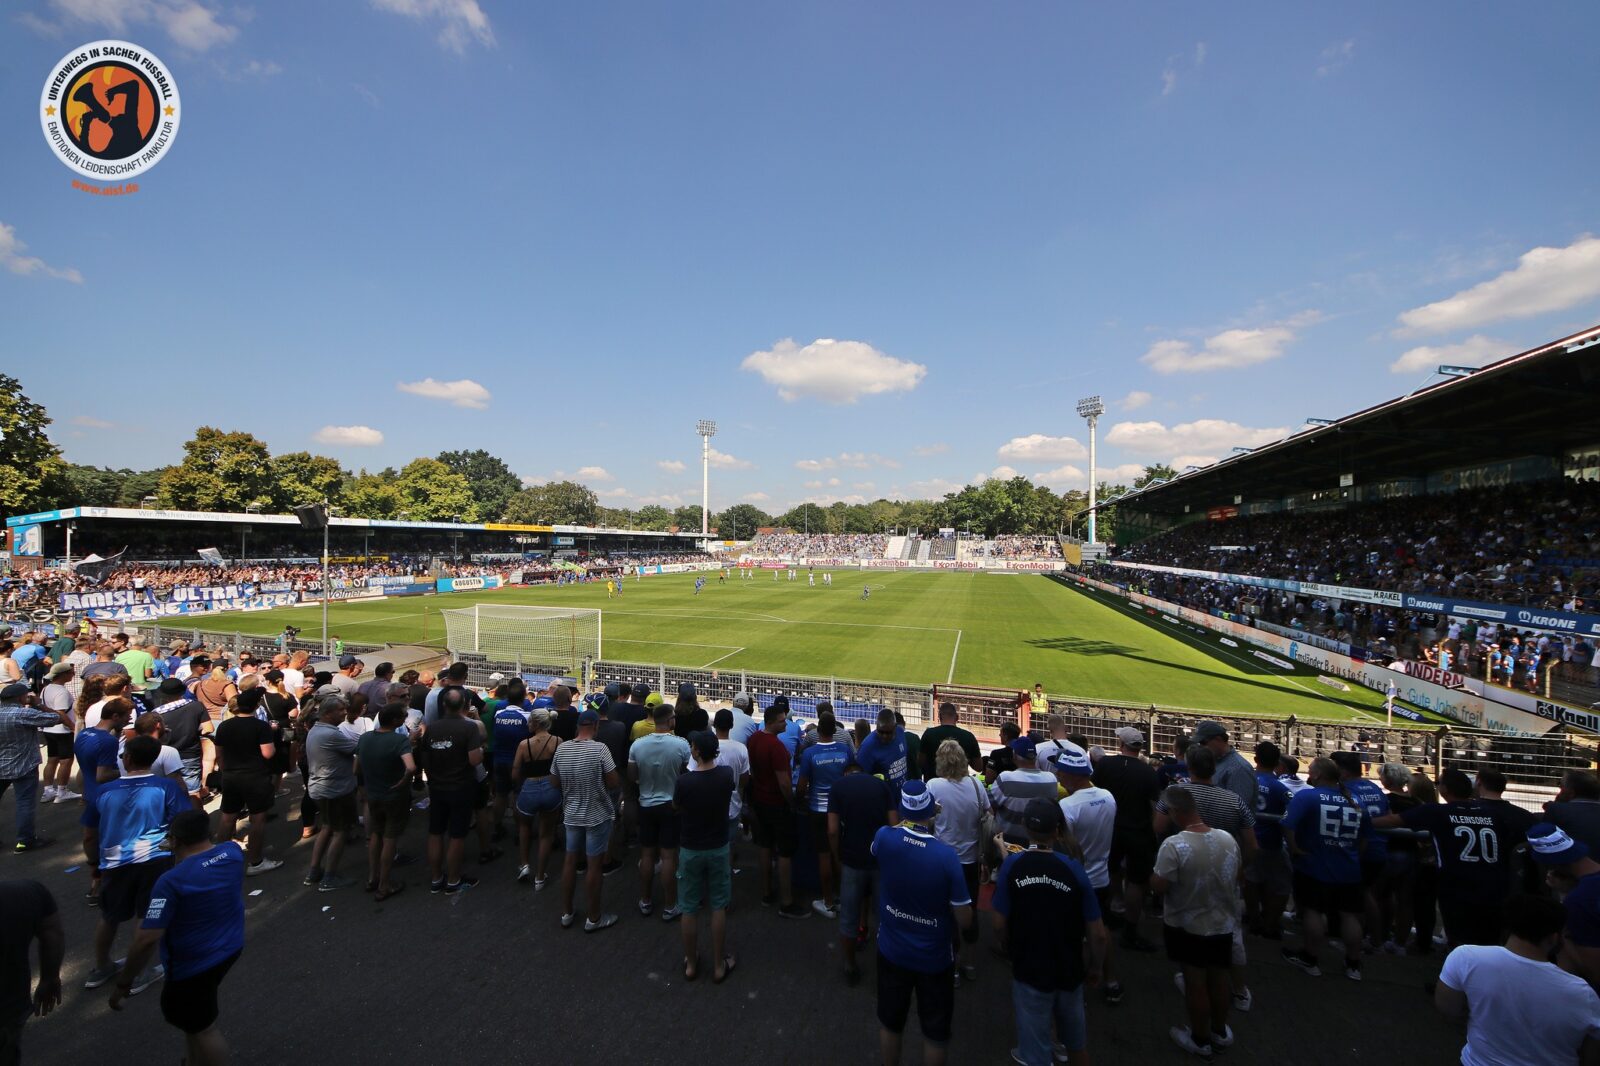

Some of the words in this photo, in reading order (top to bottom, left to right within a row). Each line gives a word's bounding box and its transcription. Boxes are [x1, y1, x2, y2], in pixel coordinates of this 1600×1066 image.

[806, 558, 845, 567] ExxonMobil
[867, 559, 910, 568] ExxonMobil
[933, 560, 978, 569] ExxonMobil
[1006, 561, 1055, 570] ExxonMobil
[454, 578, 482, 587] AUGUSTIN
[174, 585, 243, 601] ULTRA
[1373, 591, 1401, 601] H.RAKEL
[1416, 600, 1444, 610] KRONE
[1531, 616, 1577, 629] KRONE
[1324, 659, 1402, 698] Baustoffwere
[1409, 688, 1431, 708] Gute
[1433, 696, 1458, 718] Jobs
[501, 717, 522, 726] MEPPEN
[1320, 793, 1330, 801] SV
[1320, 804, 1362, 839] 69
[1449, 814, 1494, 826] KLEINSORGE
[1454, 825, 1499, 864] 20
[209, 853, 228, 865] MEPPEN
[1015, 874, 1072, 893] Fanbeauftragter
